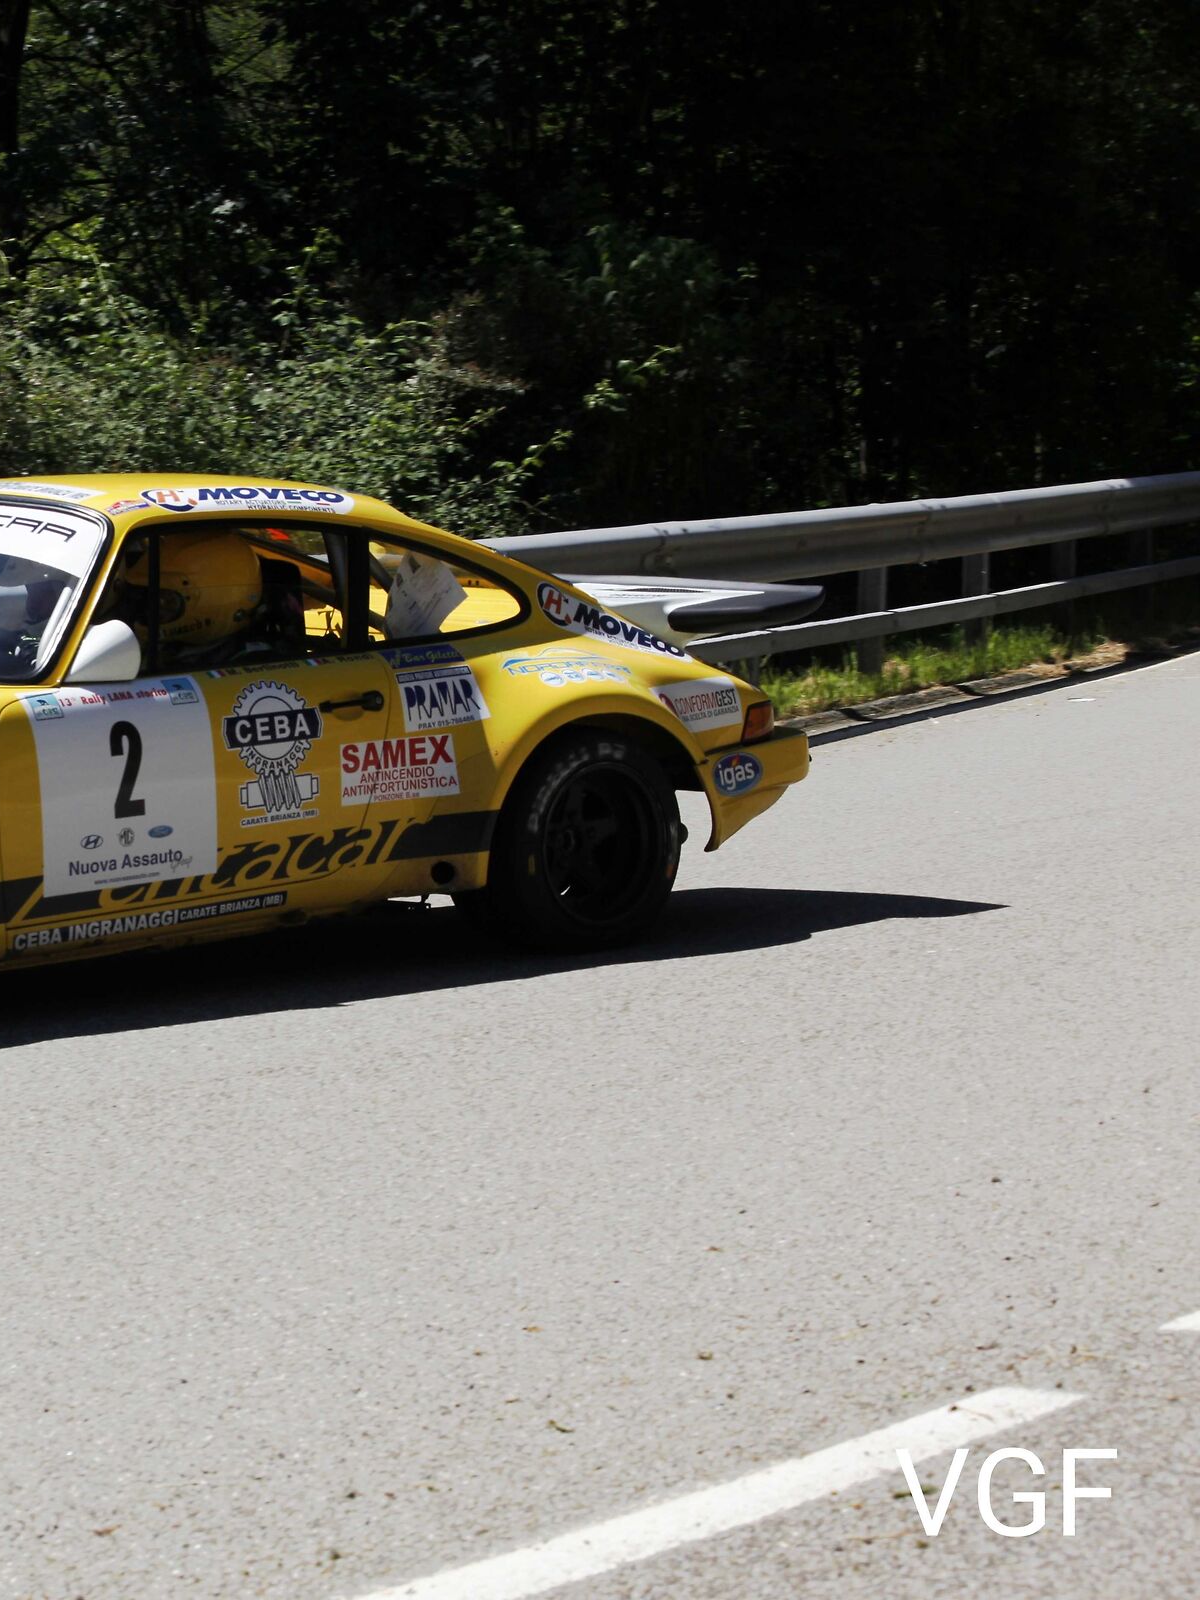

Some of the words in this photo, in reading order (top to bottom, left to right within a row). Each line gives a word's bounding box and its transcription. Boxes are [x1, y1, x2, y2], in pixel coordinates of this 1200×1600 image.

[198, 487, 345, 503] MOVECO
[288, 505, 336, 514] COMPONENTS
[573, 602, 685, 658] MOVECO
[80, 695, 107, 705] Rally
[107, 691, 133, 701] LANA
[404, 678, 481, 722] PRAMAR
[674, 688, 737, 715] CONFORMGEST
[235, 713, 311, 744] CEBA
[246, 742, 304, 769] INGRANAGGI
[342, 735, 454, 775] SAMEX
[109, 720, 146, 819] 2
[360, 765, 435, 784] ANTINCENDIO
[718, 762, 755, 791] igas
[342, 775, 458, 798] ANTINFORTUNISTICA
[240, 816, 269, 827] CARATE
[270, 812, 301, 823] BRIANZA
[302, 809, 318, 818] (MB)
[68, 858, 118, 877] Nuova
[121, 849, 183, 870] Assauto
[14, 927, 63, 950] CEBA
[68, 909, 179, 941] INGRANAGGI
[180, 905, 218, 921] CARATE
[219, 898, 261, 914] BRIANZA
[262, 894, 284, 908] (MB)
